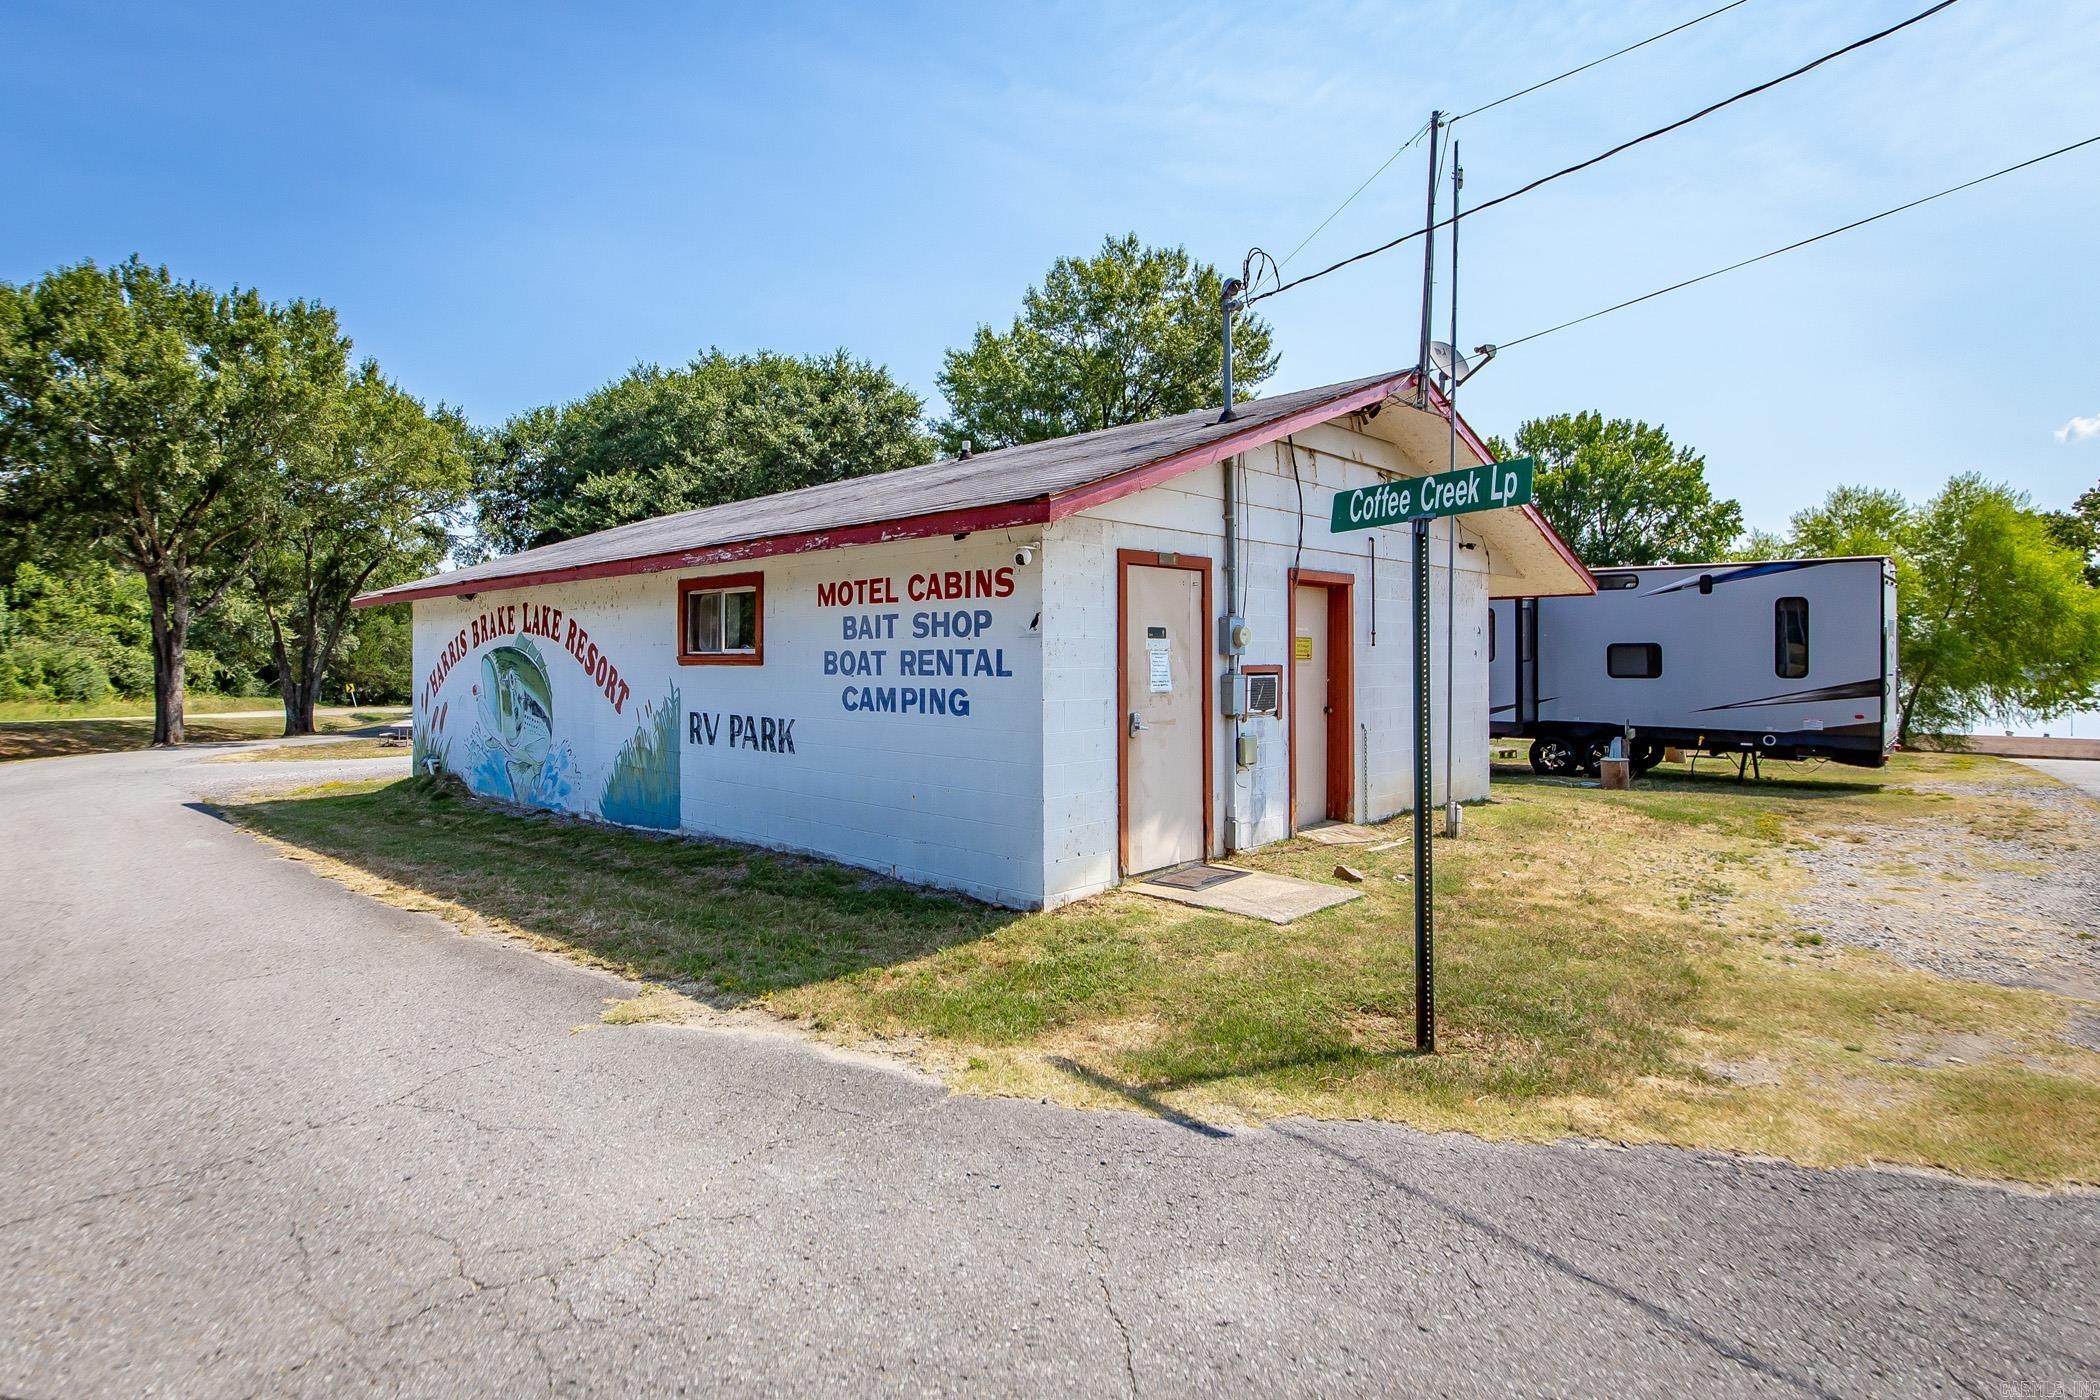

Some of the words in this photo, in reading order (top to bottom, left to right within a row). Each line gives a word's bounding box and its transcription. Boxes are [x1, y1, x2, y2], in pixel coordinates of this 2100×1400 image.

[1350, 485, 1411, 522] Coffee
[1421, 470, 1481, 511] Creek
[1490, 465, 1517, 507] Lp
[817, 577, 899, 607] MOTEL
[907, 567, 1015, 602] CABINS
[842, 613, 899, 640] BAIT
[912, 610, 993, 638] SHOP
[429, 629, 468, 698] HARRIS
[471, 605, 516, 649] BRAKE
[522, 602, 562, 643] LAKE
[565, 618, 631, 715] RESORT
[823, 650, 886, 676] BOAT
[900, 648, 1013, 677] RENTAL
[841, 686, 970, 717] CAMPING
[689, 711, 720, 746] RV
[729, 715, 796, 755] PARK
